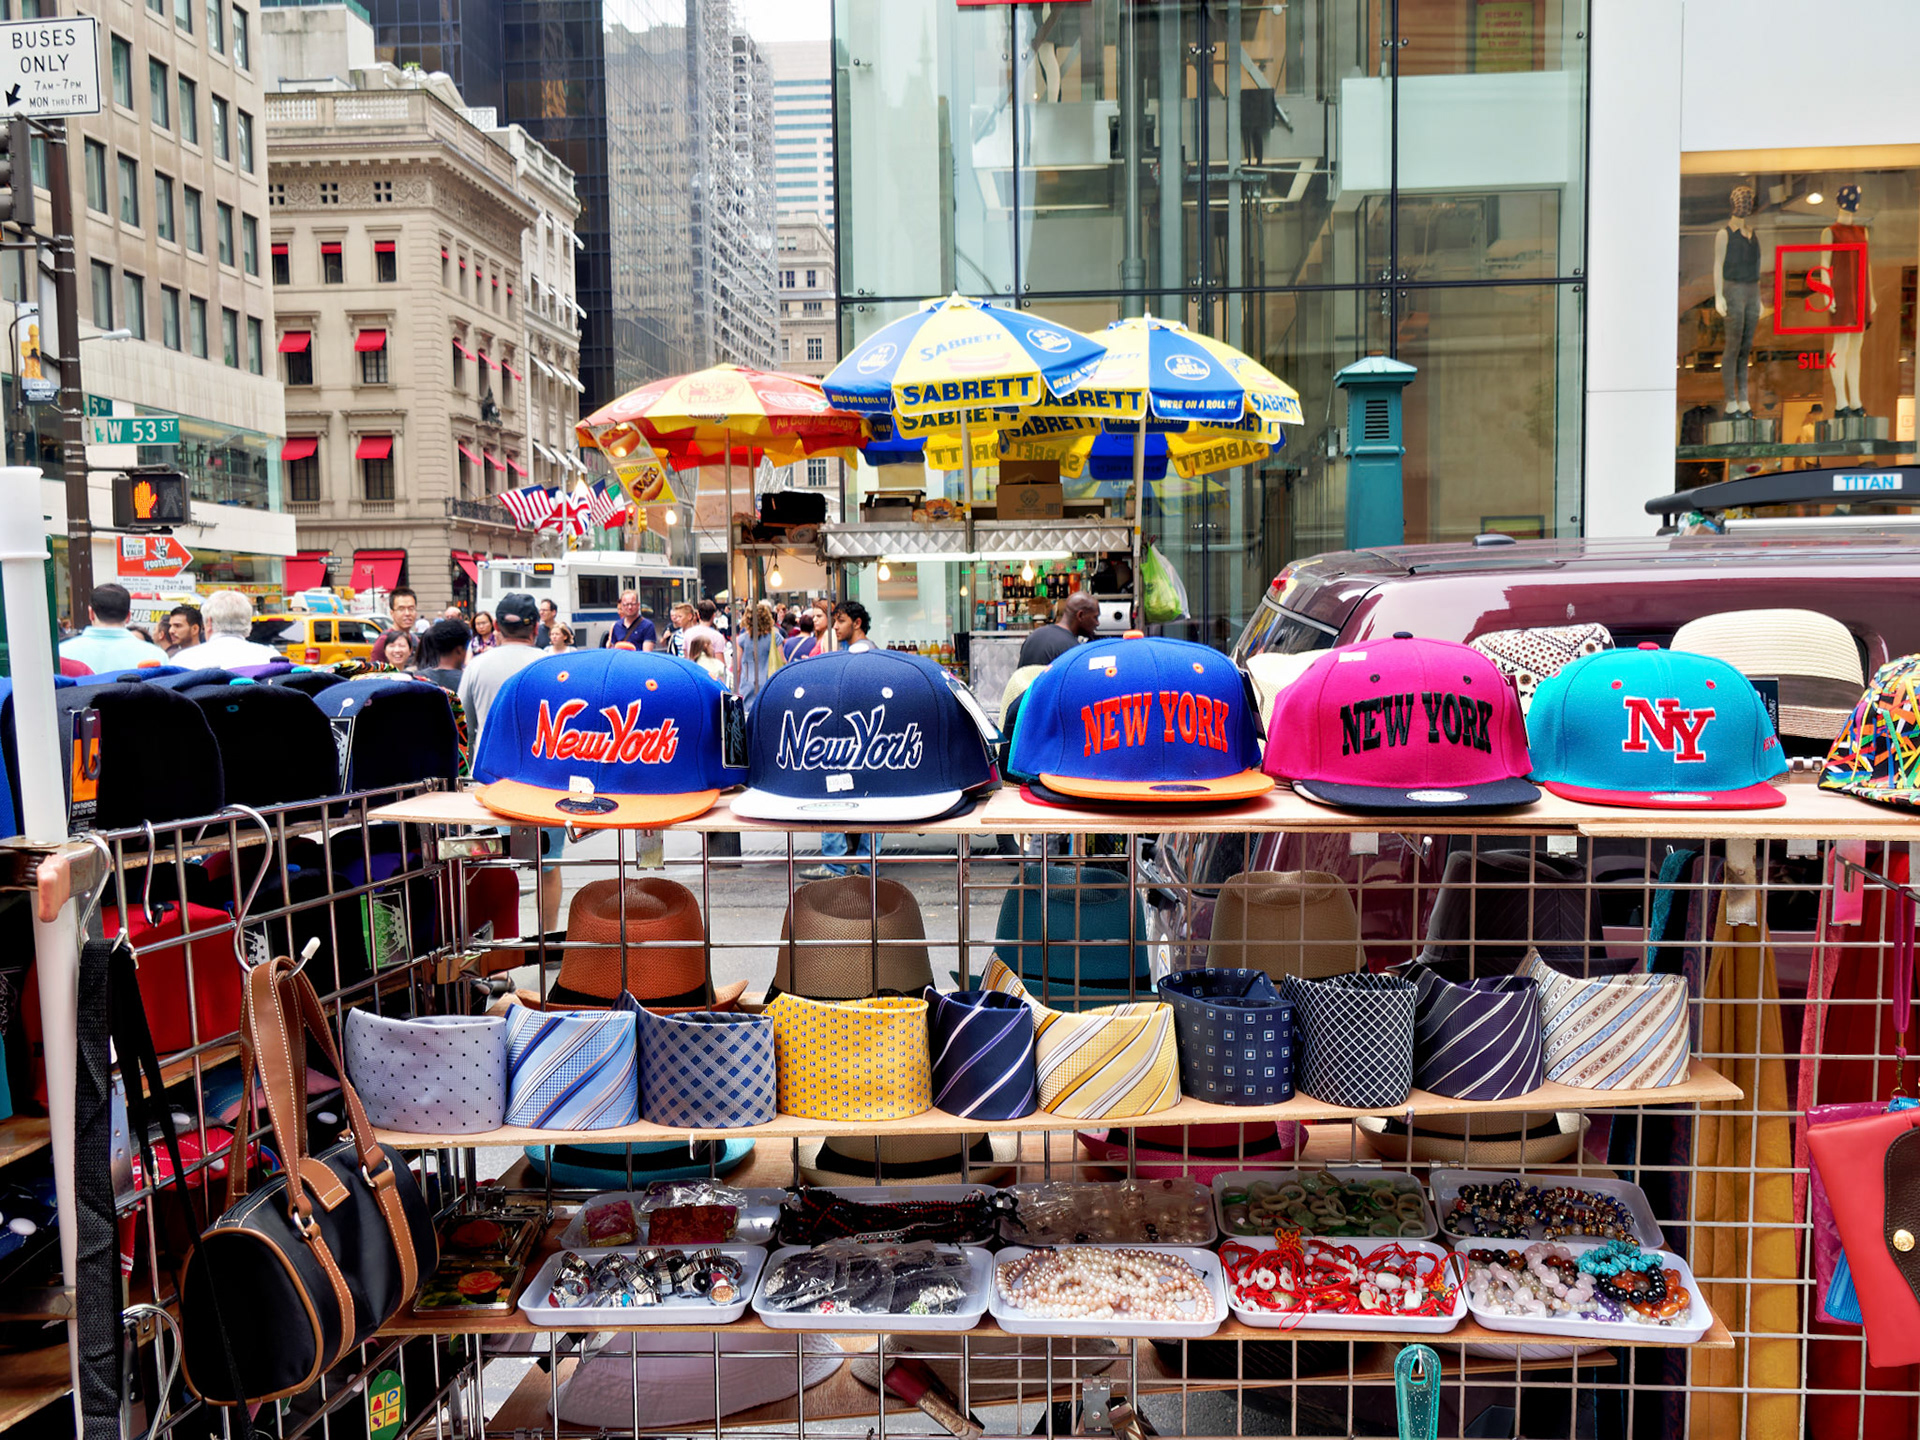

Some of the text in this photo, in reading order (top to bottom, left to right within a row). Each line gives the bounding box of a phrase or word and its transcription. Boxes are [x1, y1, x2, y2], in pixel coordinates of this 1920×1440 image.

[12, 28, 76, 49] BUSES
[20, 54, 69, 73] ONLY
[29, 97, 49, 108] MON
[72, 94, 88, 105] FRI
[1805, 266, 1834, 313] S
[1797, 352, 1836, 370] SILK
[903, 376, 1033, 405] SABRETT
[1033, 389, 1141, 410] ABRETT
[91, 397, 99, 416] 5
[1159, 399, 1184, 409] WE'RE
[1185, 400, 1198, 409] ON
[1198, 399, 1205, 408] A
[1206, 400, 1226, 409] ROLL
[1251, 393, 1301, 415] SABRETT
[108, 421, 175, 442] W 53 ST
[1842, 476, 1894, 491] TITAN
[130, 608, 171, 623] SUBW
[1081, 691, 1229, 757] NEW YORK
[1340, 692, 1493, 756] NEW YORK
[1622, 695, 1717, 763] NY
